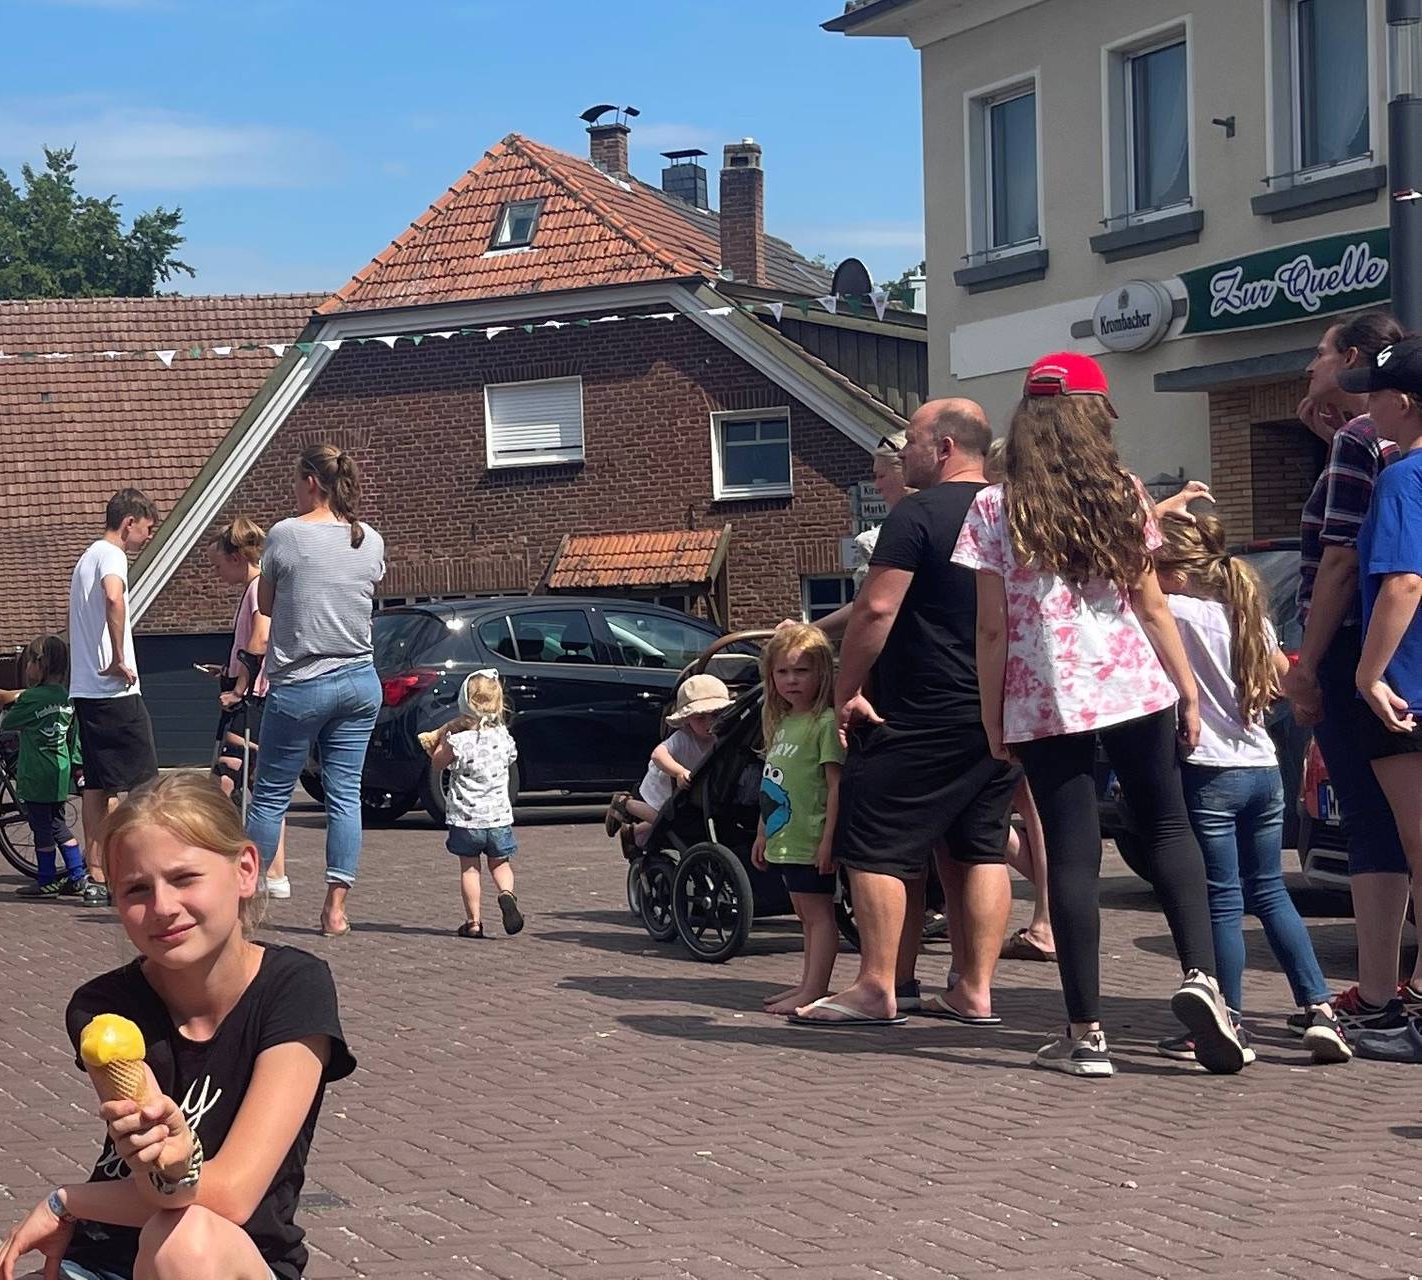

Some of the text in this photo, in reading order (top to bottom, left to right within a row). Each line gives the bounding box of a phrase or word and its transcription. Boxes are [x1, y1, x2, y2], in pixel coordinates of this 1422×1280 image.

[1210, 242, 1388, 317] Zur Quelle
[1100, 309, 1151, 335] Krombacher
[863, 503, 886, 514] Markt
